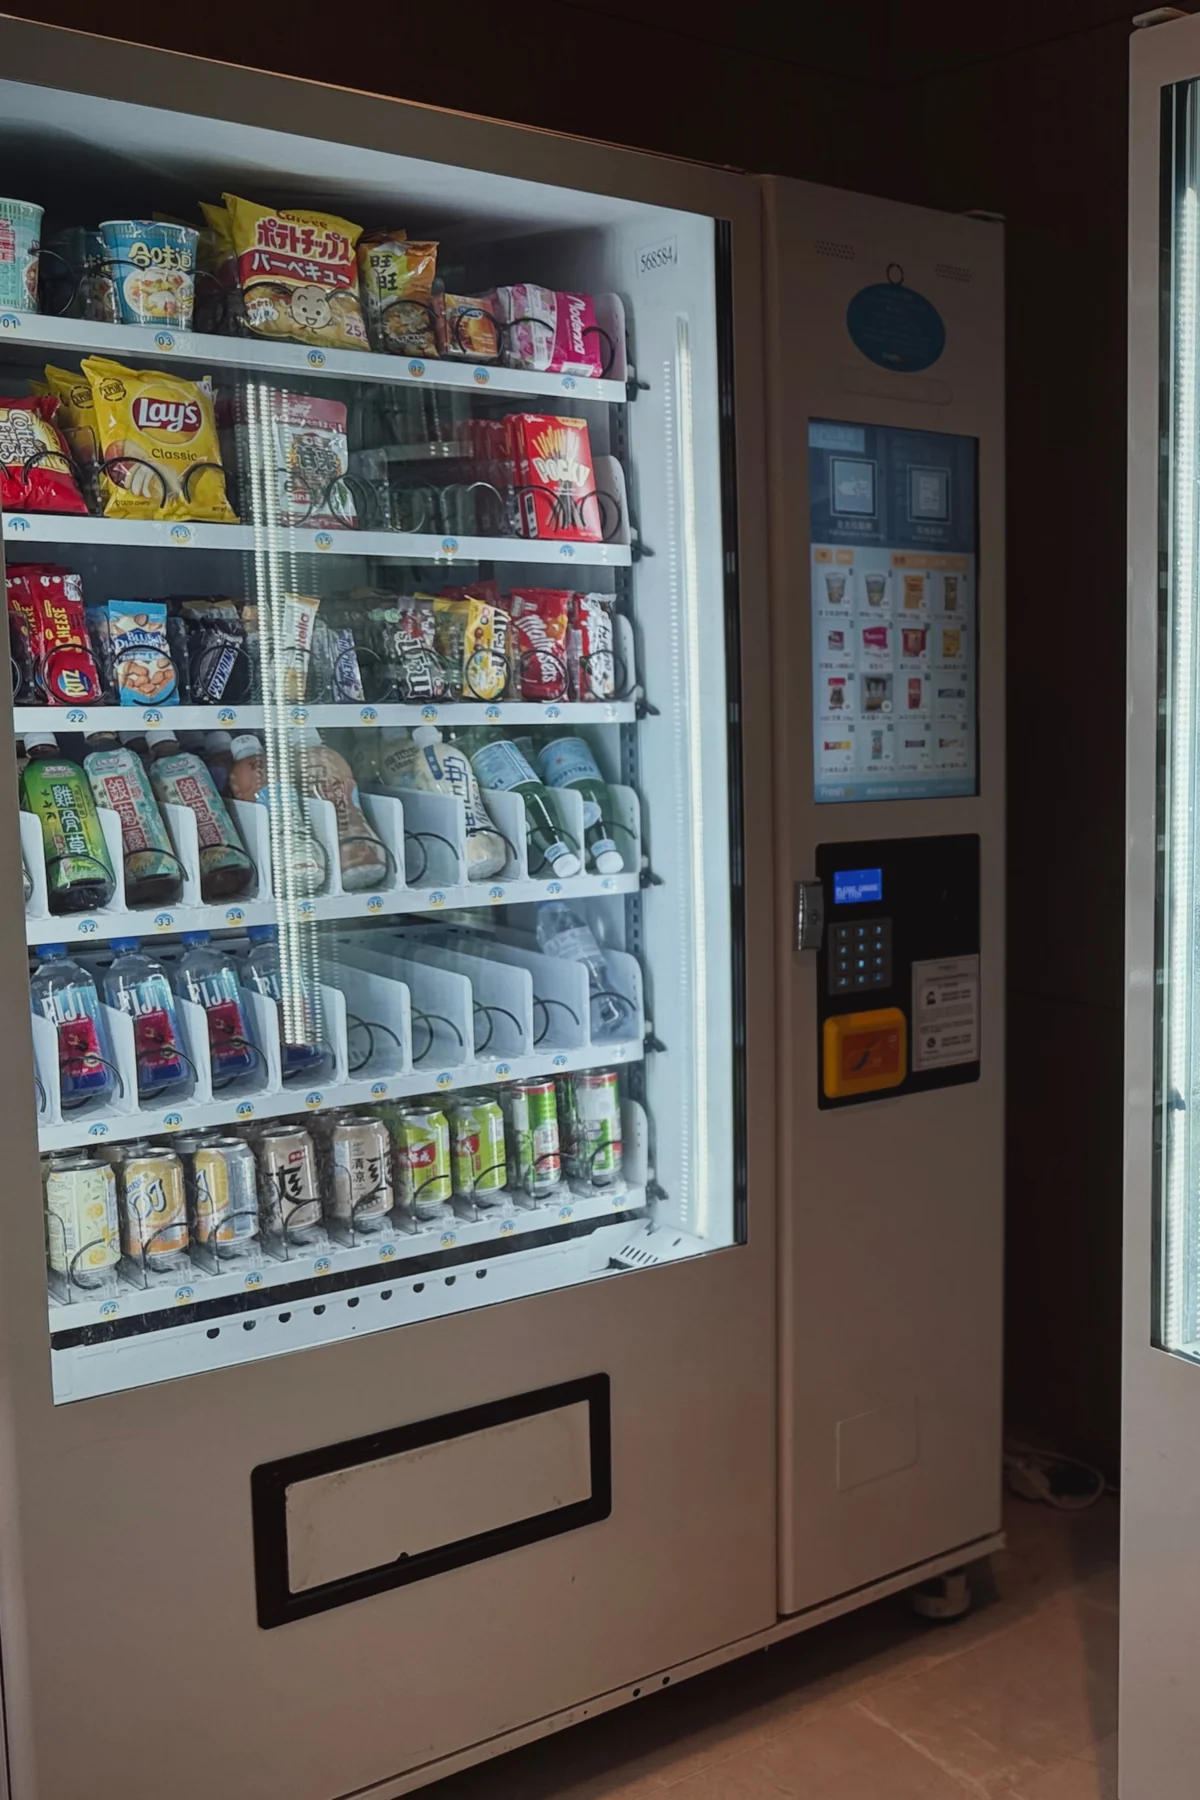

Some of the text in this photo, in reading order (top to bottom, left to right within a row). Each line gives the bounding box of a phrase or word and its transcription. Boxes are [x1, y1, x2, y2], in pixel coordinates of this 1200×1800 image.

[256, 218, 351, 264] ポテトチップス
[128, 242, 192, 272] 合味道
[640, 246, 674, 273] 568584
[252, 252, 350, 286] バーベキュー
[370, 254, 398, 291] 旺旺
[138, 398, 200, 432] Lay's
[152, 448, 198, 462] Classic
[532, 456, 590, 488] POCKY
[12, 521, 27, 532] 11
[53, 607, 71, 647] CHEESE
[516, 614, 556, 684] Maltesers
[208, 647, 239, 700] SNICKERS
[62, 670, 88, 697] RITZ
[68, 712, 85, 724] 22
[146, 712, 161, 723] 23
[220, 712, 235, 722] 24
[362, 712, 376, 722] 26
[424, 710, 436, 720] 27
[488, 708, 501, 718] 28
[548, 708, 560, 718] 29
[370, 900, 383, 910] 36
[156, 916, 172, 928] 33
[228, 910, 243, 922] 34
[82, 922, 97, 934] 32
[190, 974, 232, 1007] FIJI
[118, 982, 160, 1019] FIJI
[40, 988, 87, 1026] FIJI
[306, 1095, 322, 1106] 45
[238, 1104, 254, 1115] 44
[166, 1116, 181, 1127] 43
[90, 1126, 107, 1137] 42
[380, 1248, 396, 1258] 56
[316, 1261, 331, 1272] 55
[247, 1276, 262, 1286] 54
[178, 1289, 193, 1301] 53
[102, 1304, 118, 1316] 52
